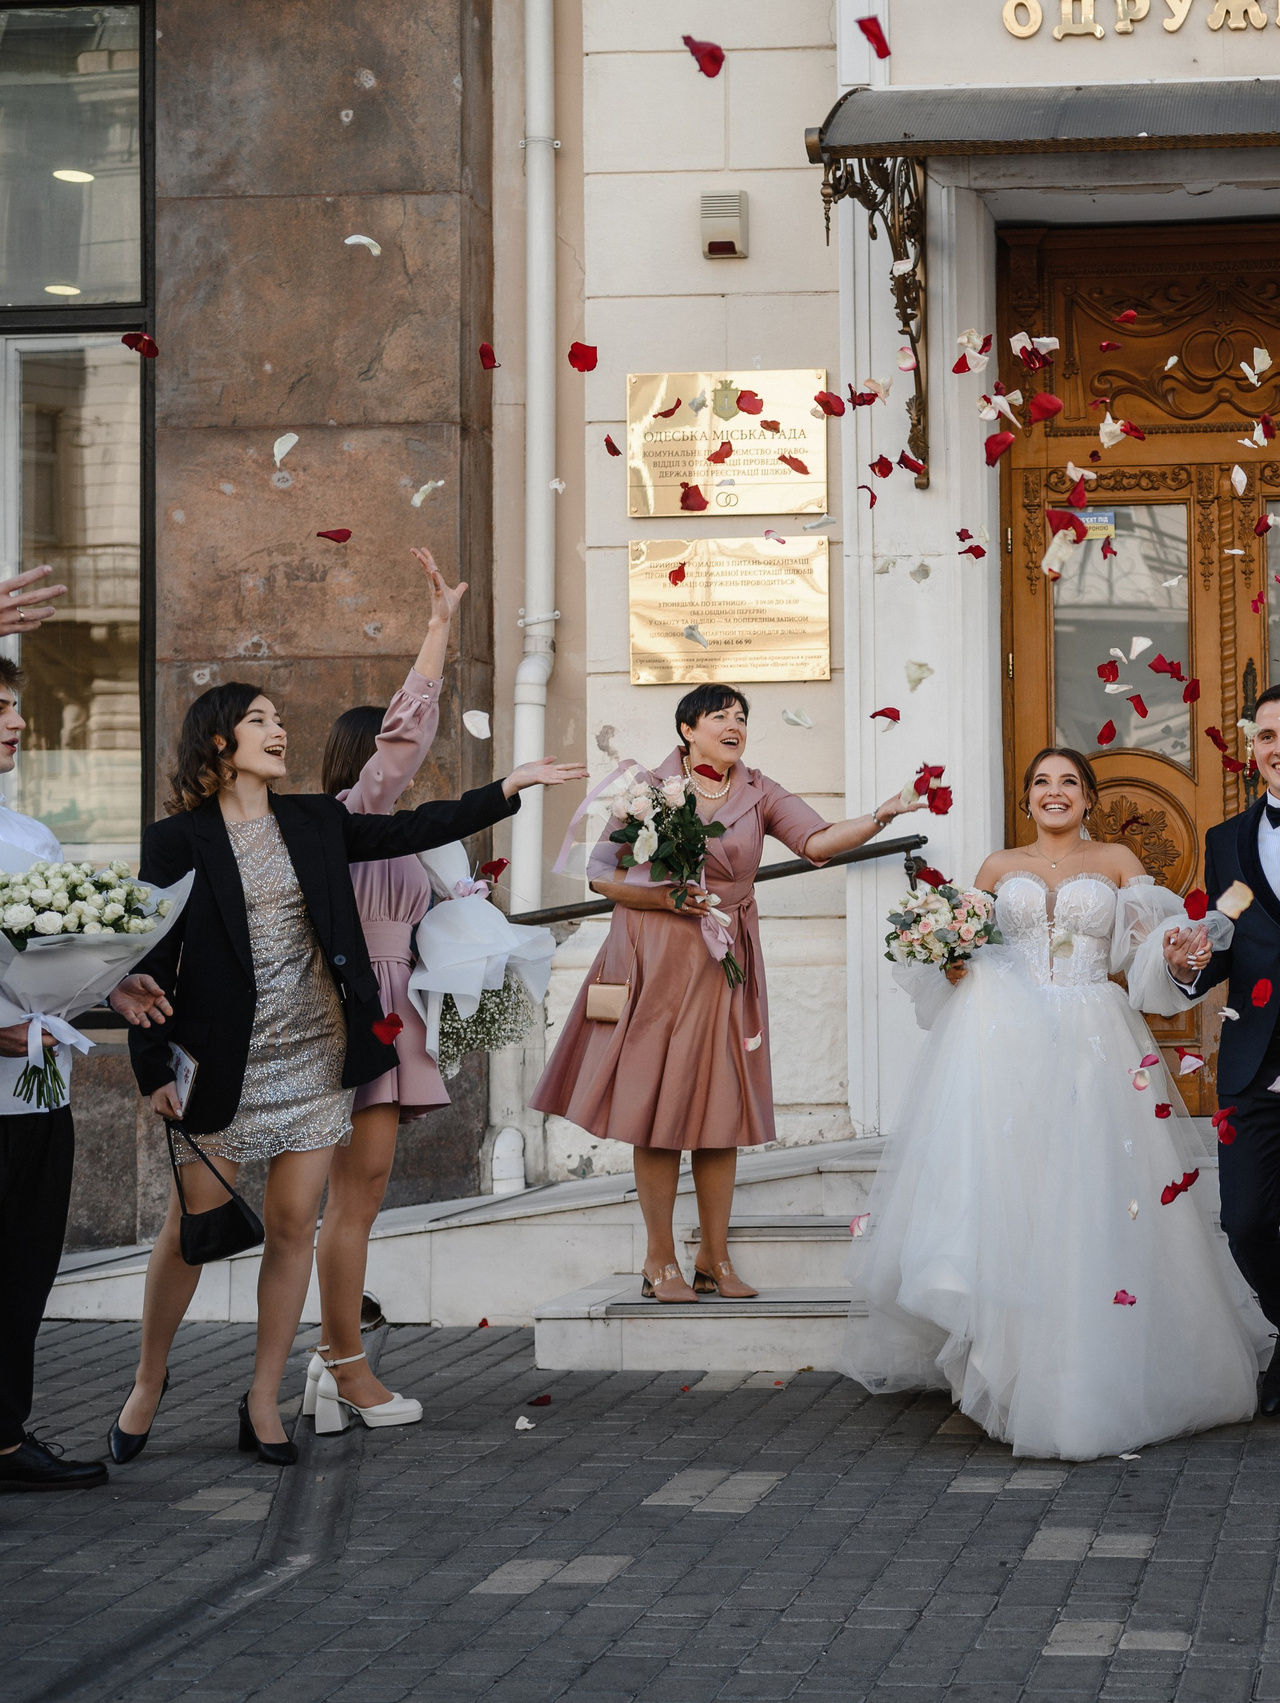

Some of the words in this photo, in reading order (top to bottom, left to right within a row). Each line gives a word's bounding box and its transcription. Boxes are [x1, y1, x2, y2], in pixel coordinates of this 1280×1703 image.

[643, 430, 708, 444] ОДЕСЬКА
[712, 429, 766, 441] МІСЬКА
[643, 449, 702, 458] КОМУНАЛЬНЕ
[652, 460, 680, 468] ВІДДІЛ
[658, 469, 709, 479] ДЕРЖАВНОЇ
[710, 468, 759, 477] РЕЄСТРАЦІЇ
